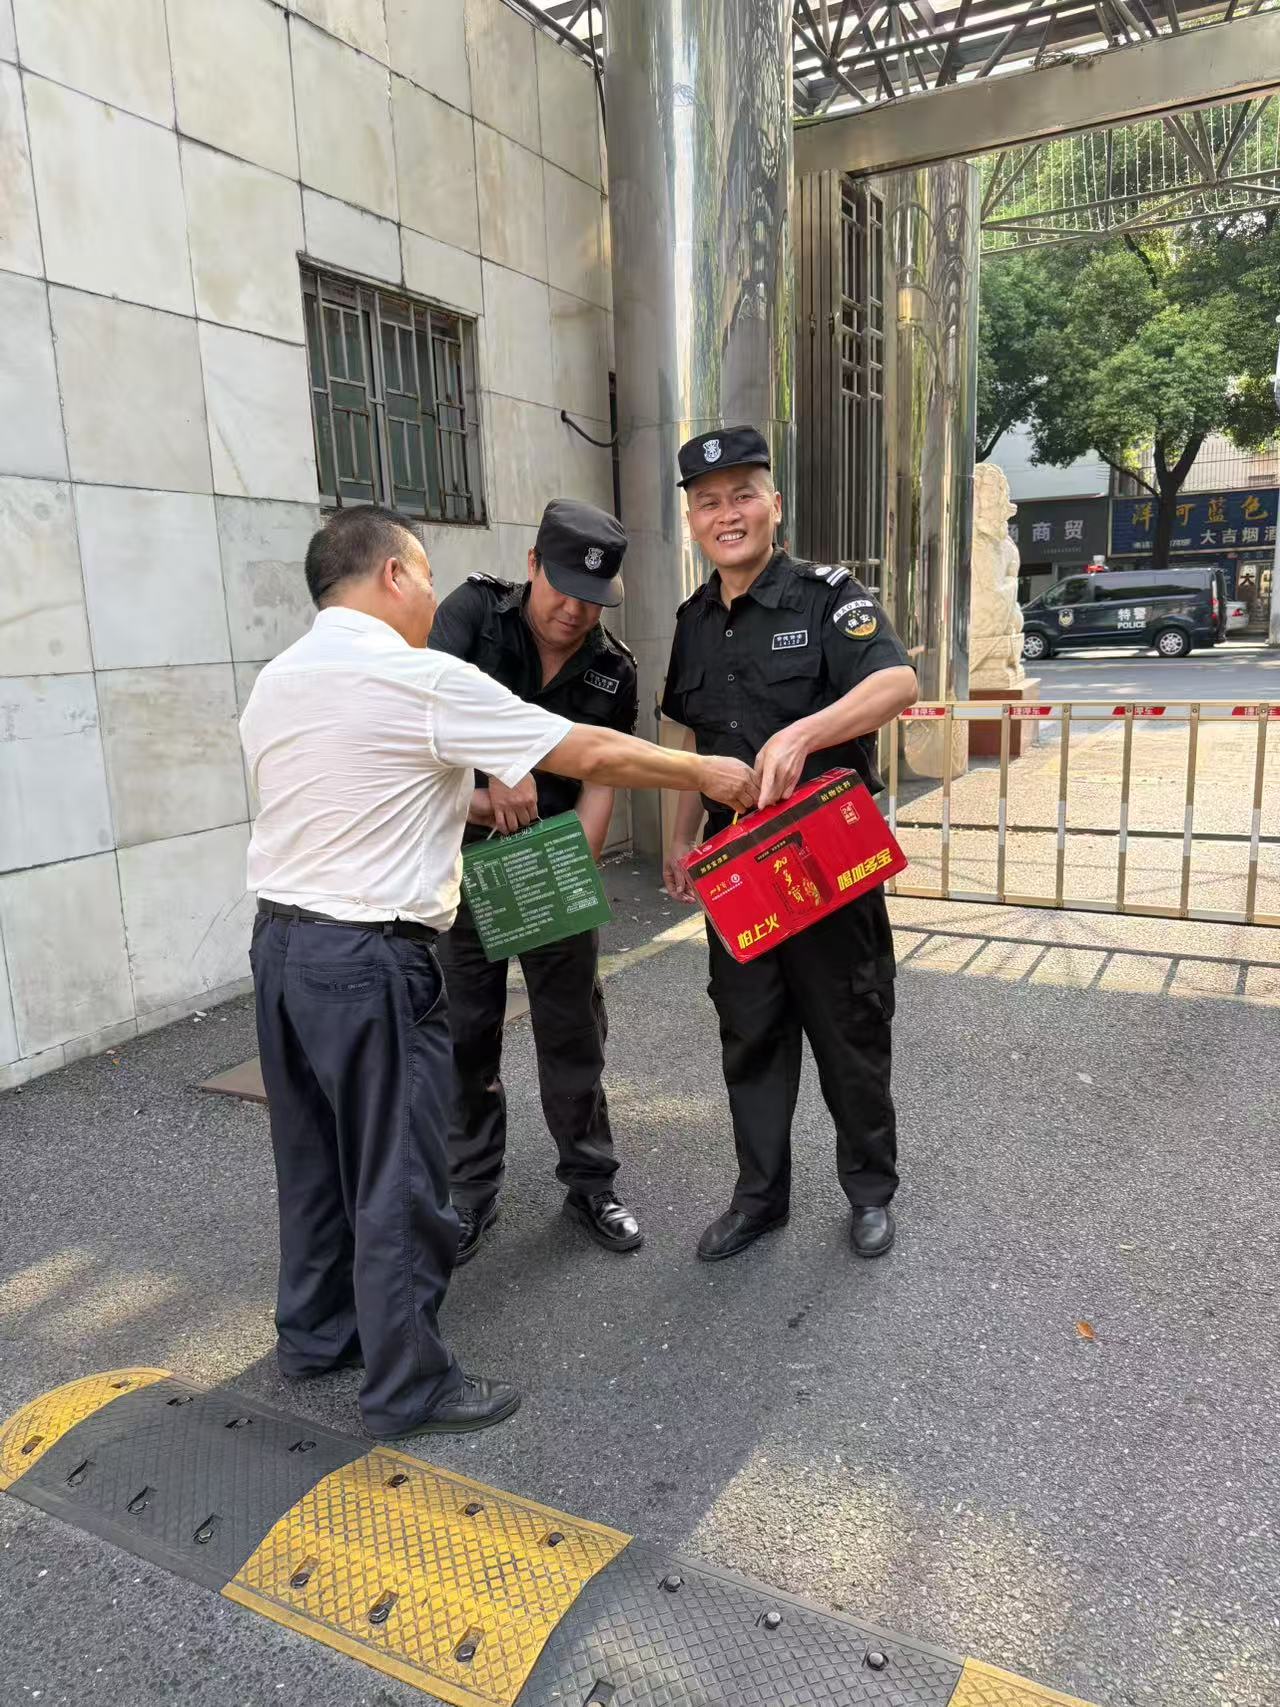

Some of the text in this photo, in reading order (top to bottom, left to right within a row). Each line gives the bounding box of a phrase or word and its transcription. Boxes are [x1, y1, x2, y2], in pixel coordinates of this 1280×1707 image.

[848, 614, 871, 628] 保安
[1117, 621, 1146, 629] POLICE
[837, 848, 893, 891] 喝加多宝
[737, 912, 780, 950] 怕上火
